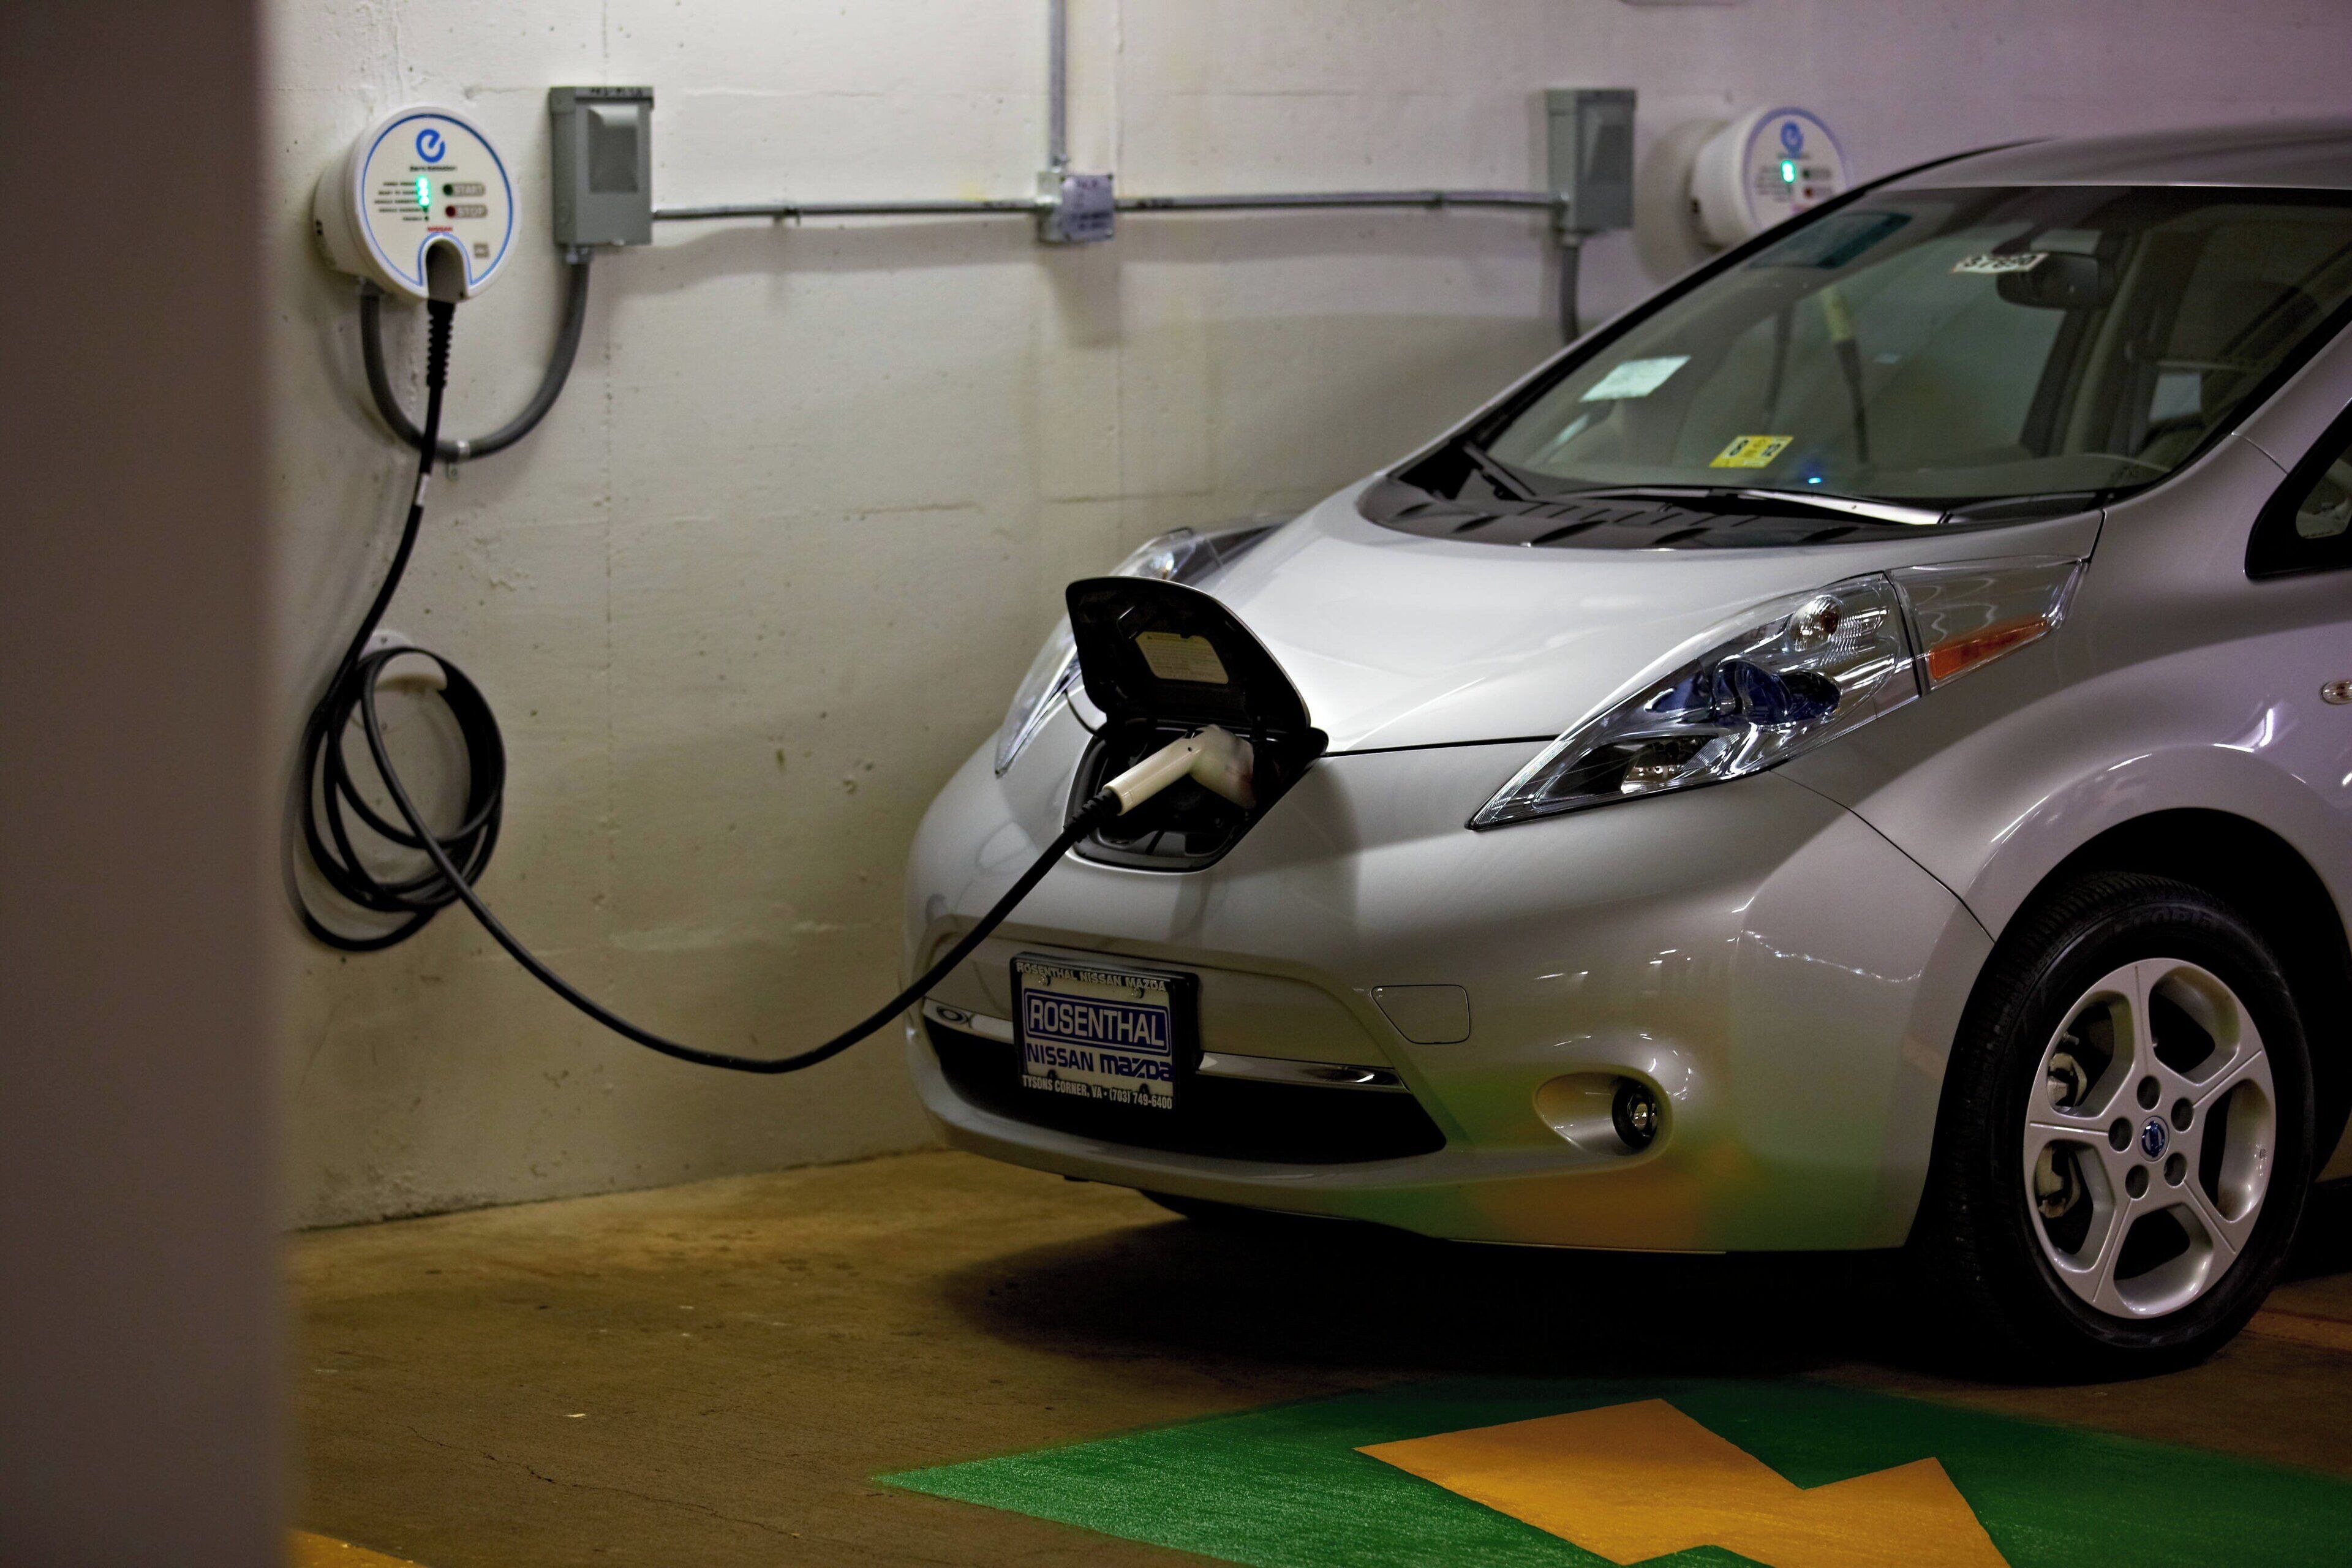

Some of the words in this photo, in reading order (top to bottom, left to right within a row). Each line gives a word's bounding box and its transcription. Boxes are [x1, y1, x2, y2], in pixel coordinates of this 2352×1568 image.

[1017, 963, 1075, 979] ROSENTHAL
[1079, 971, 1121, 986] NISSAN
[1125, 976, 1166, 992] MAZDA
[1030, 999, 1164, 1046] ROSENTHAL
[1028, 1044, 1093, 1072] NISSAN
[1023, 1076, 1053, 1091] TYSONS
[1055, 1079, 1090, 1098] CORNER,
[1091, 1086, 1102, 1099] VA
[1109, 1088, 1131, 1104] (703)
[1133, 1091, 1172, 1110] 749-6400
